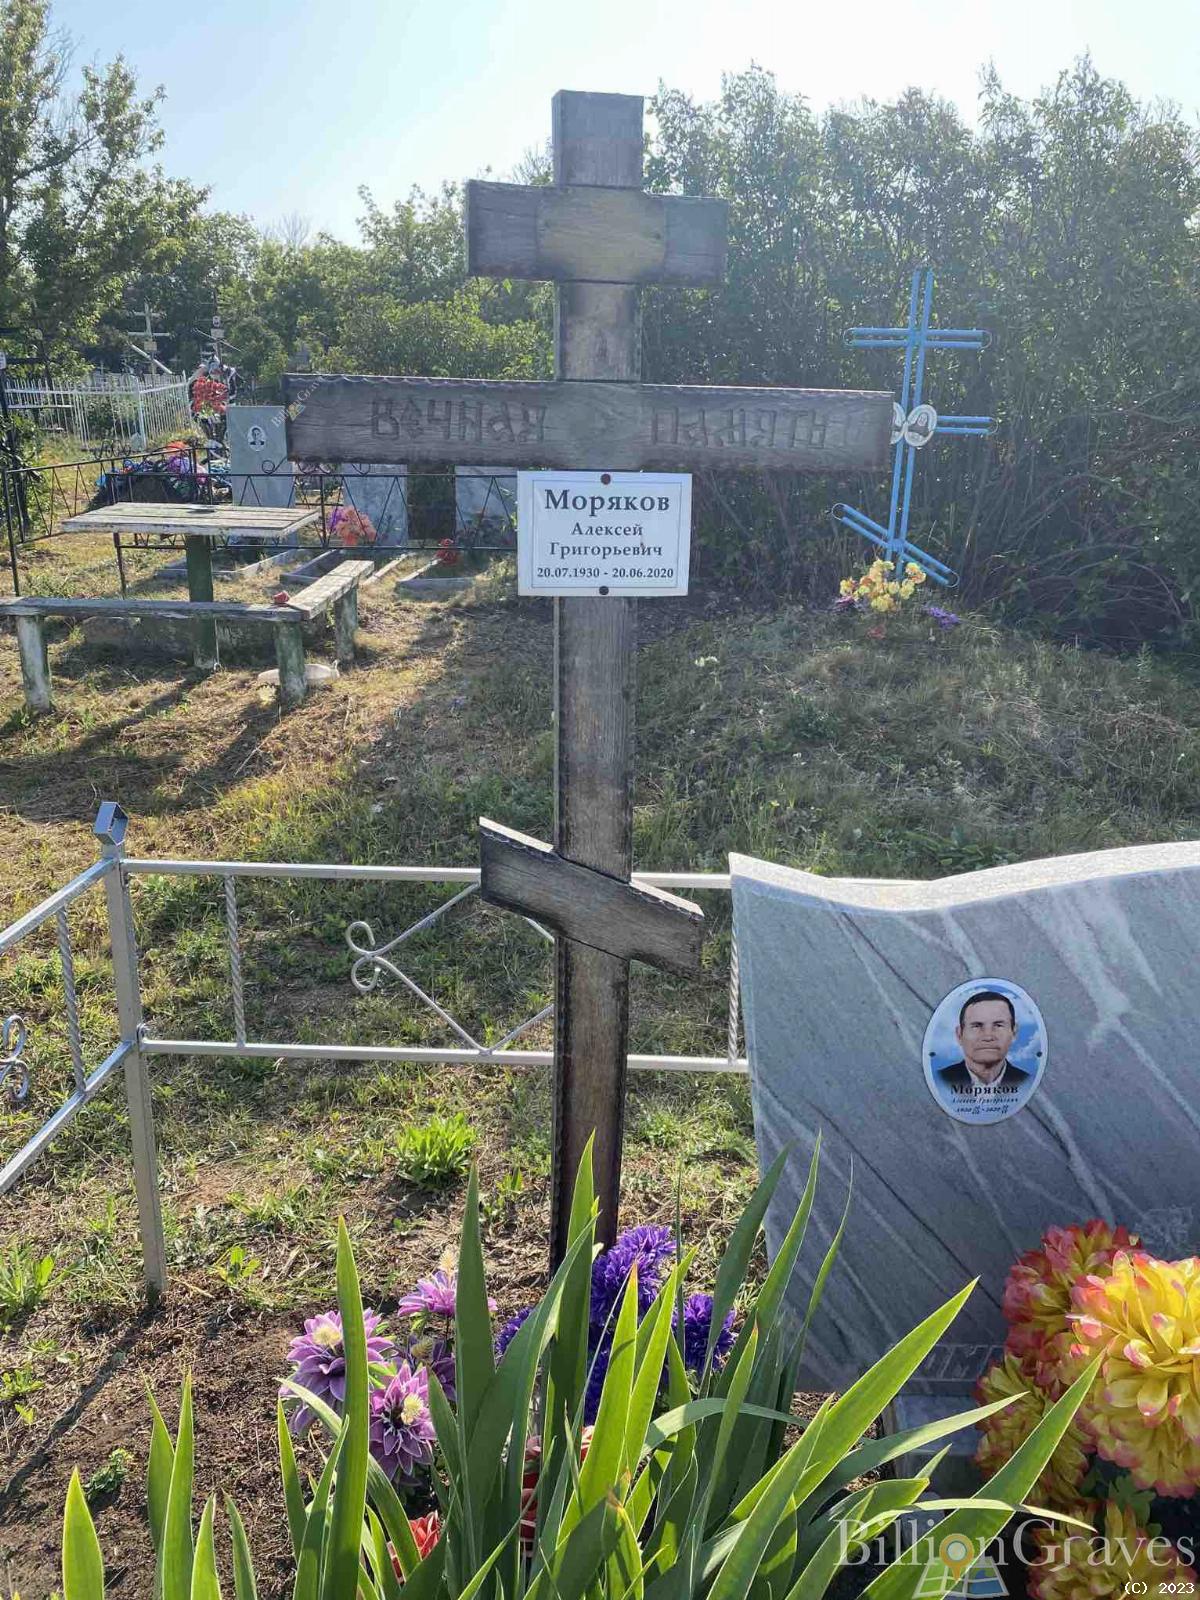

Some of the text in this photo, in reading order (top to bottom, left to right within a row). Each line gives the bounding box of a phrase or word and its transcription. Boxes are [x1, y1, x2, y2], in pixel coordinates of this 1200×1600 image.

[544, 488, 670, 517] Моряков
[571, 522, 643, 536] Алексей
[549, 542, 663, 559] Григорьевич
[537, 567, 600, 578] 20.07.1930
[612, 568, 674, 578] 20.06.2020
[950, 1084, 1018, 1097] Моряков
